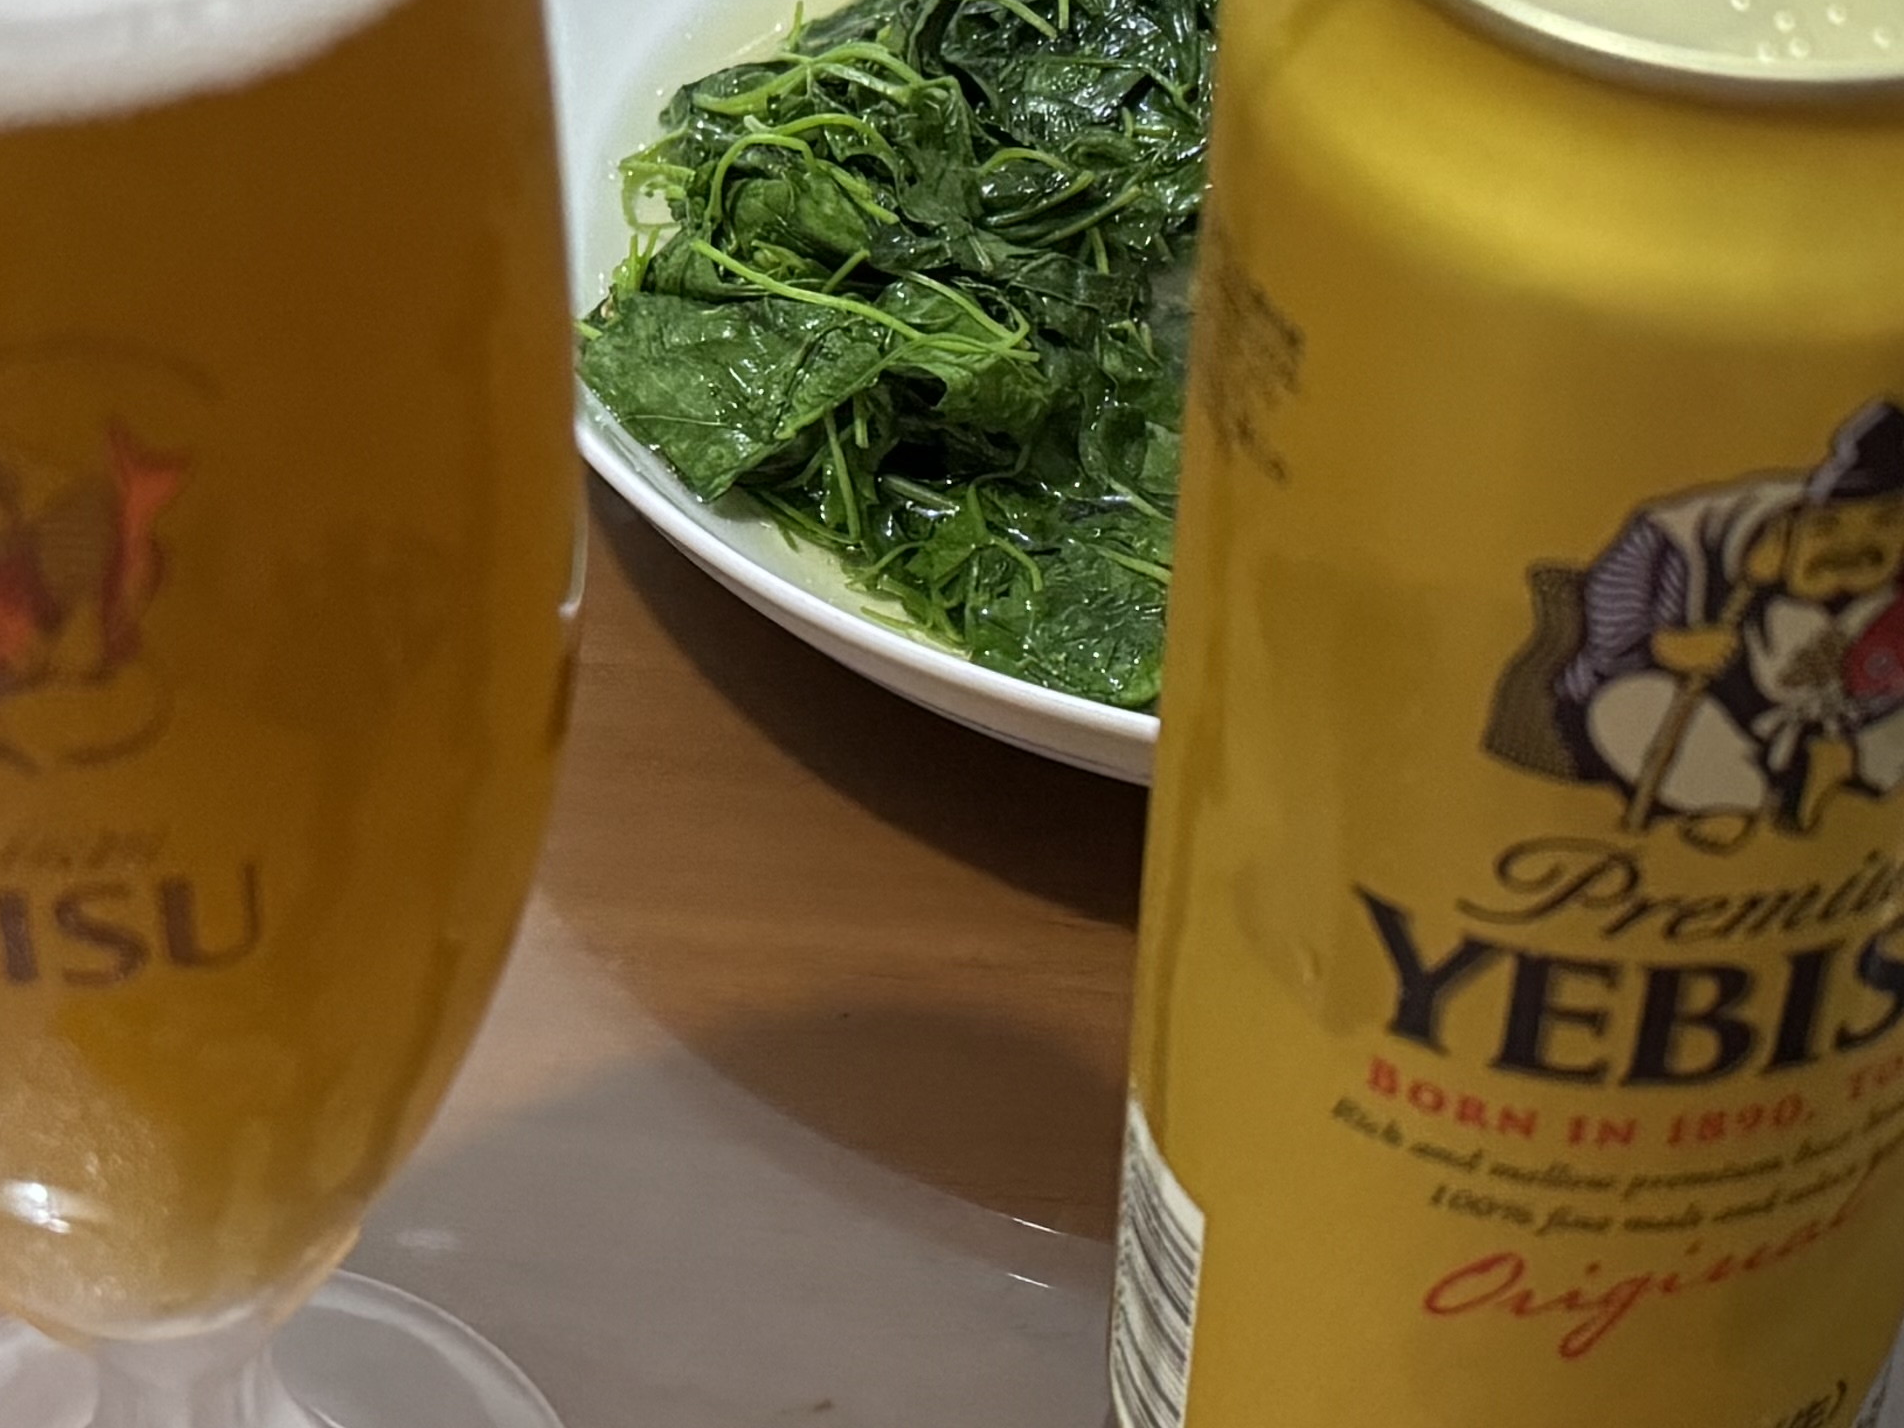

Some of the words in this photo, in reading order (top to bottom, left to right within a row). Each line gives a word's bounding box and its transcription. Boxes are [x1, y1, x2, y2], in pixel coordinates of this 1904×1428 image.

[1366, 1053, 1539, 1141] BORN
[1566, 1115, 1637, 1150] IN
[1423, 1172, 1871, 1360] Original
